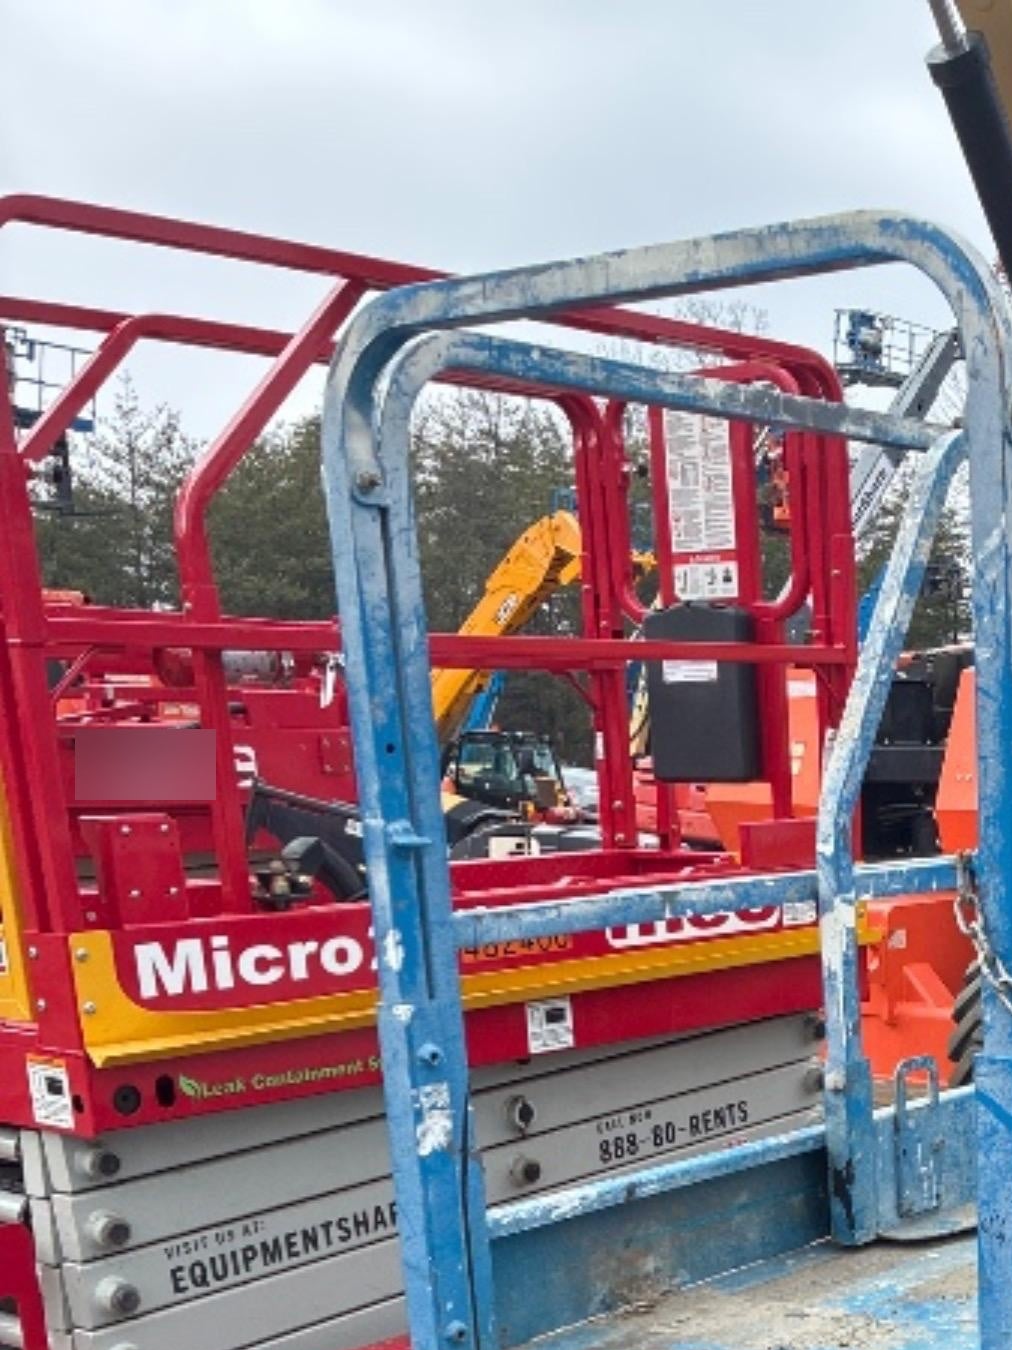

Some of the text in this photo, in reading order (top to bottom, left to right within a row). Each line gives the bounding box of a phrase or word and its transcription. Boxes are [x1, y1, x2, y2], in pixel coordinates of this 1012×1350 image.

[134, 927, 378, 1000] Micro
[202, 1056, 384, 1098] Leak Containment S
[164, 1235, 208, 1260] VISIT
[214, 1229, 235, 1245] US
